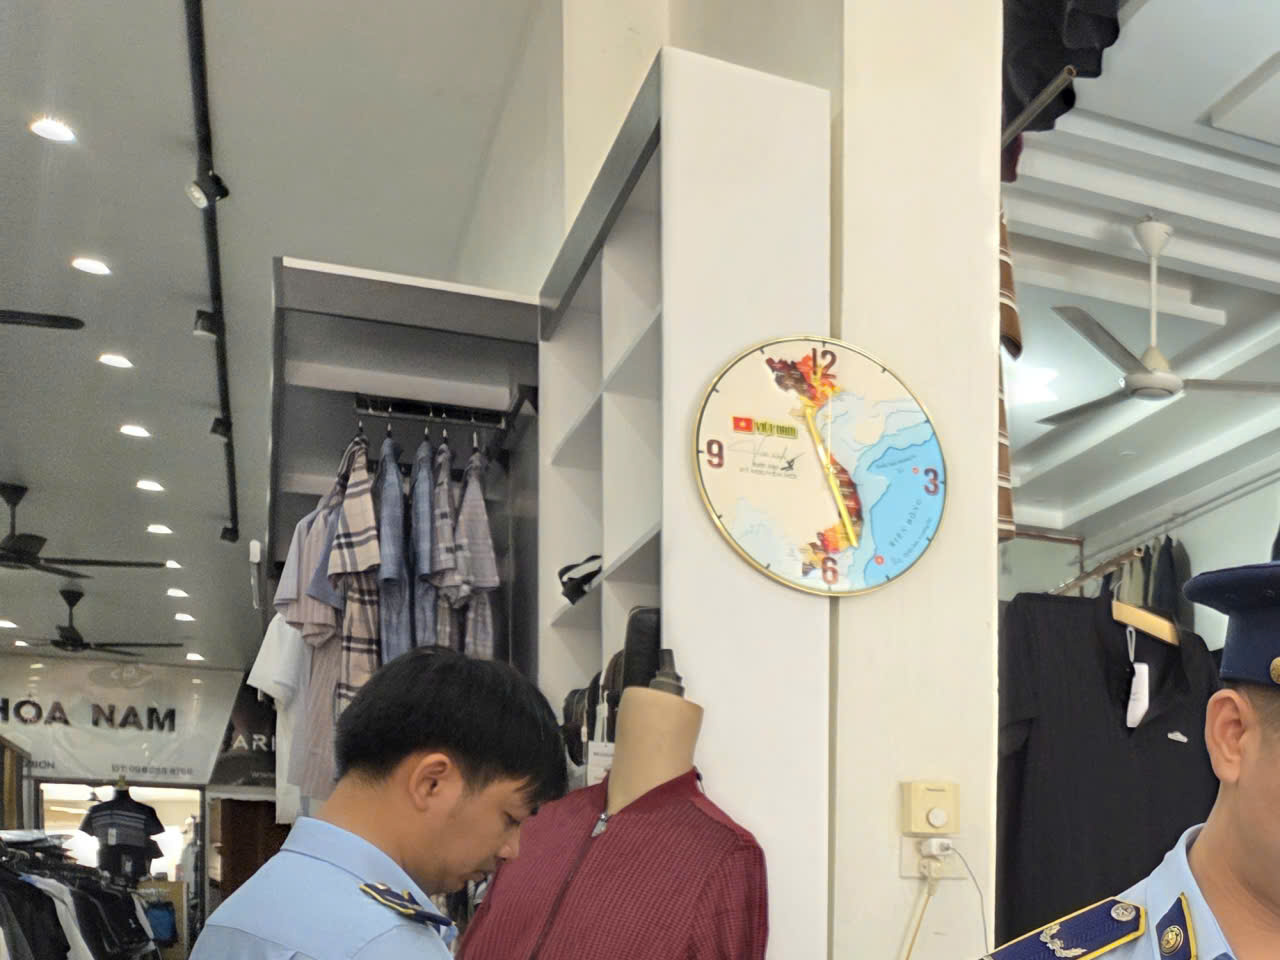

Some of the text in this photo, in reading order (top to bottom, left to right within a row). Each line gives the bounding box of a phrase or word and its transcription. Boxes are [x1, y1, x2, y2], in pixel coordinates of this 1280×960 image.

[812, 348, 837, 379] 12
[706, 439, 724, 468] 9
[924, 468, 939, 496] 3
[821, 557, 838, 585] 6
[91, 703, 176, 733] NAM
